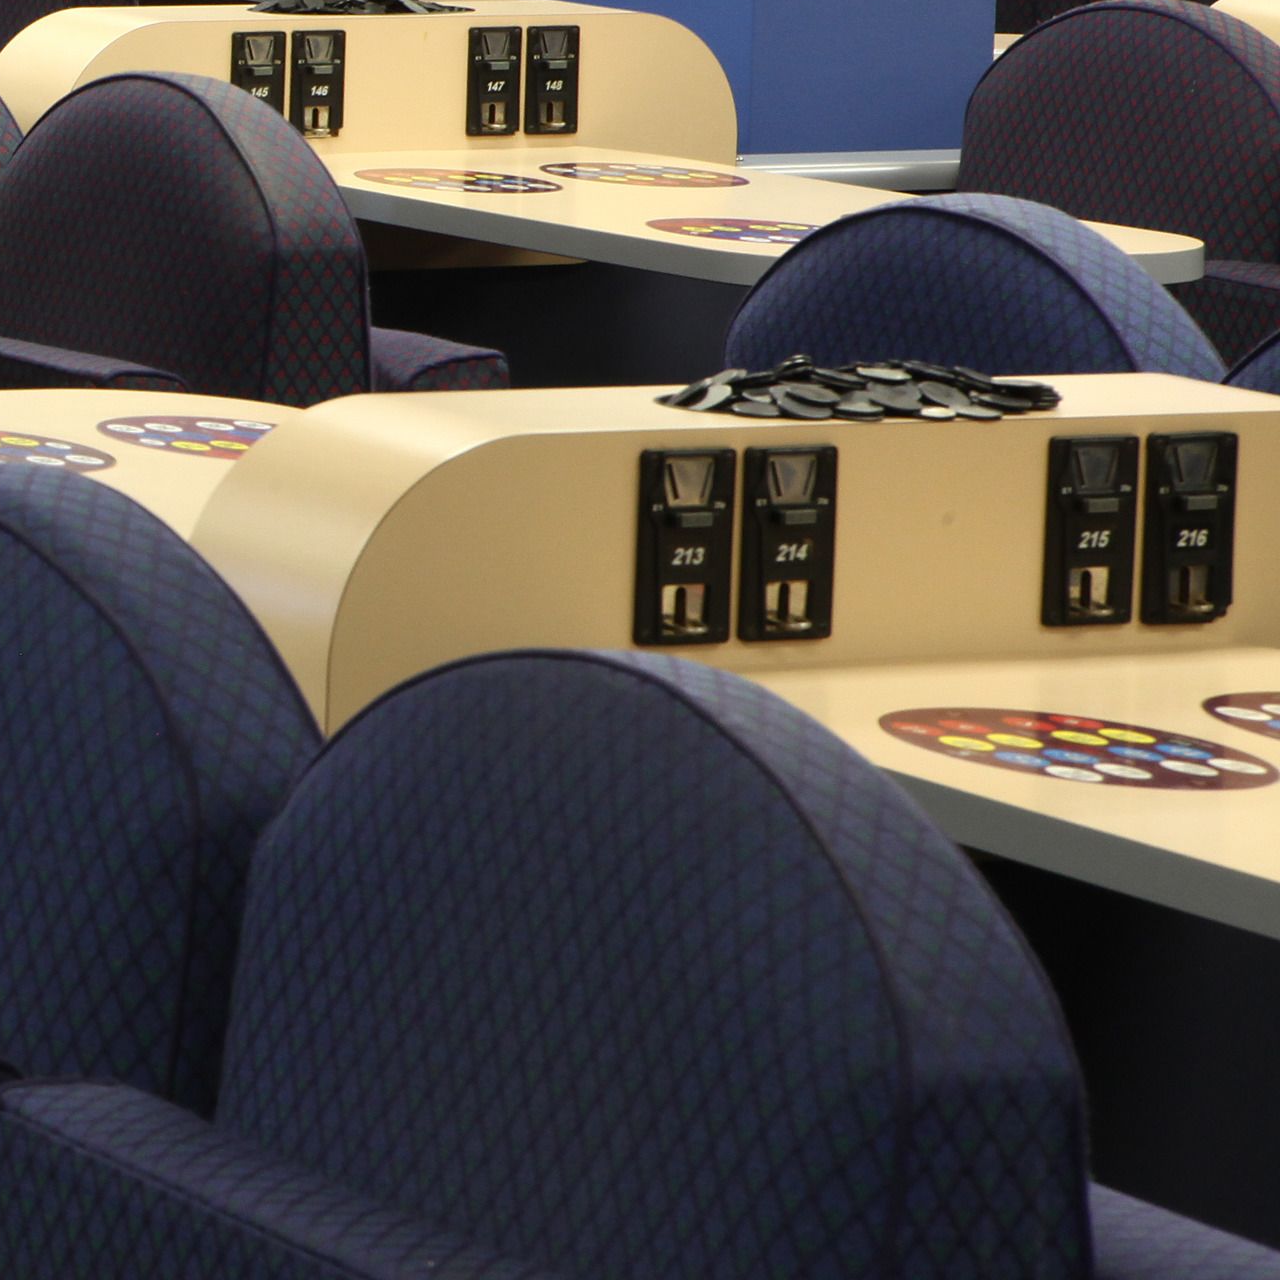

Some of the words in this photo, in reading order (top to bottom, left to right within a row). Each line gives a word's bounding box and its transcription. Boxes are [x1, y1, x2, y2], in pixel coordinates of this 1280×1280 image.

[251, 87, 268, 98] 145
[310, 85, 328, 96] 146
[487, 81, 505, 92] 147
[545, 80, 563, 91] 148
[1078, 530, 1111, 549] 215
[1177, 529, 1208, 547] 216
[671, 547, 706, 566] 213
[776, 544, 808, 562] 214
